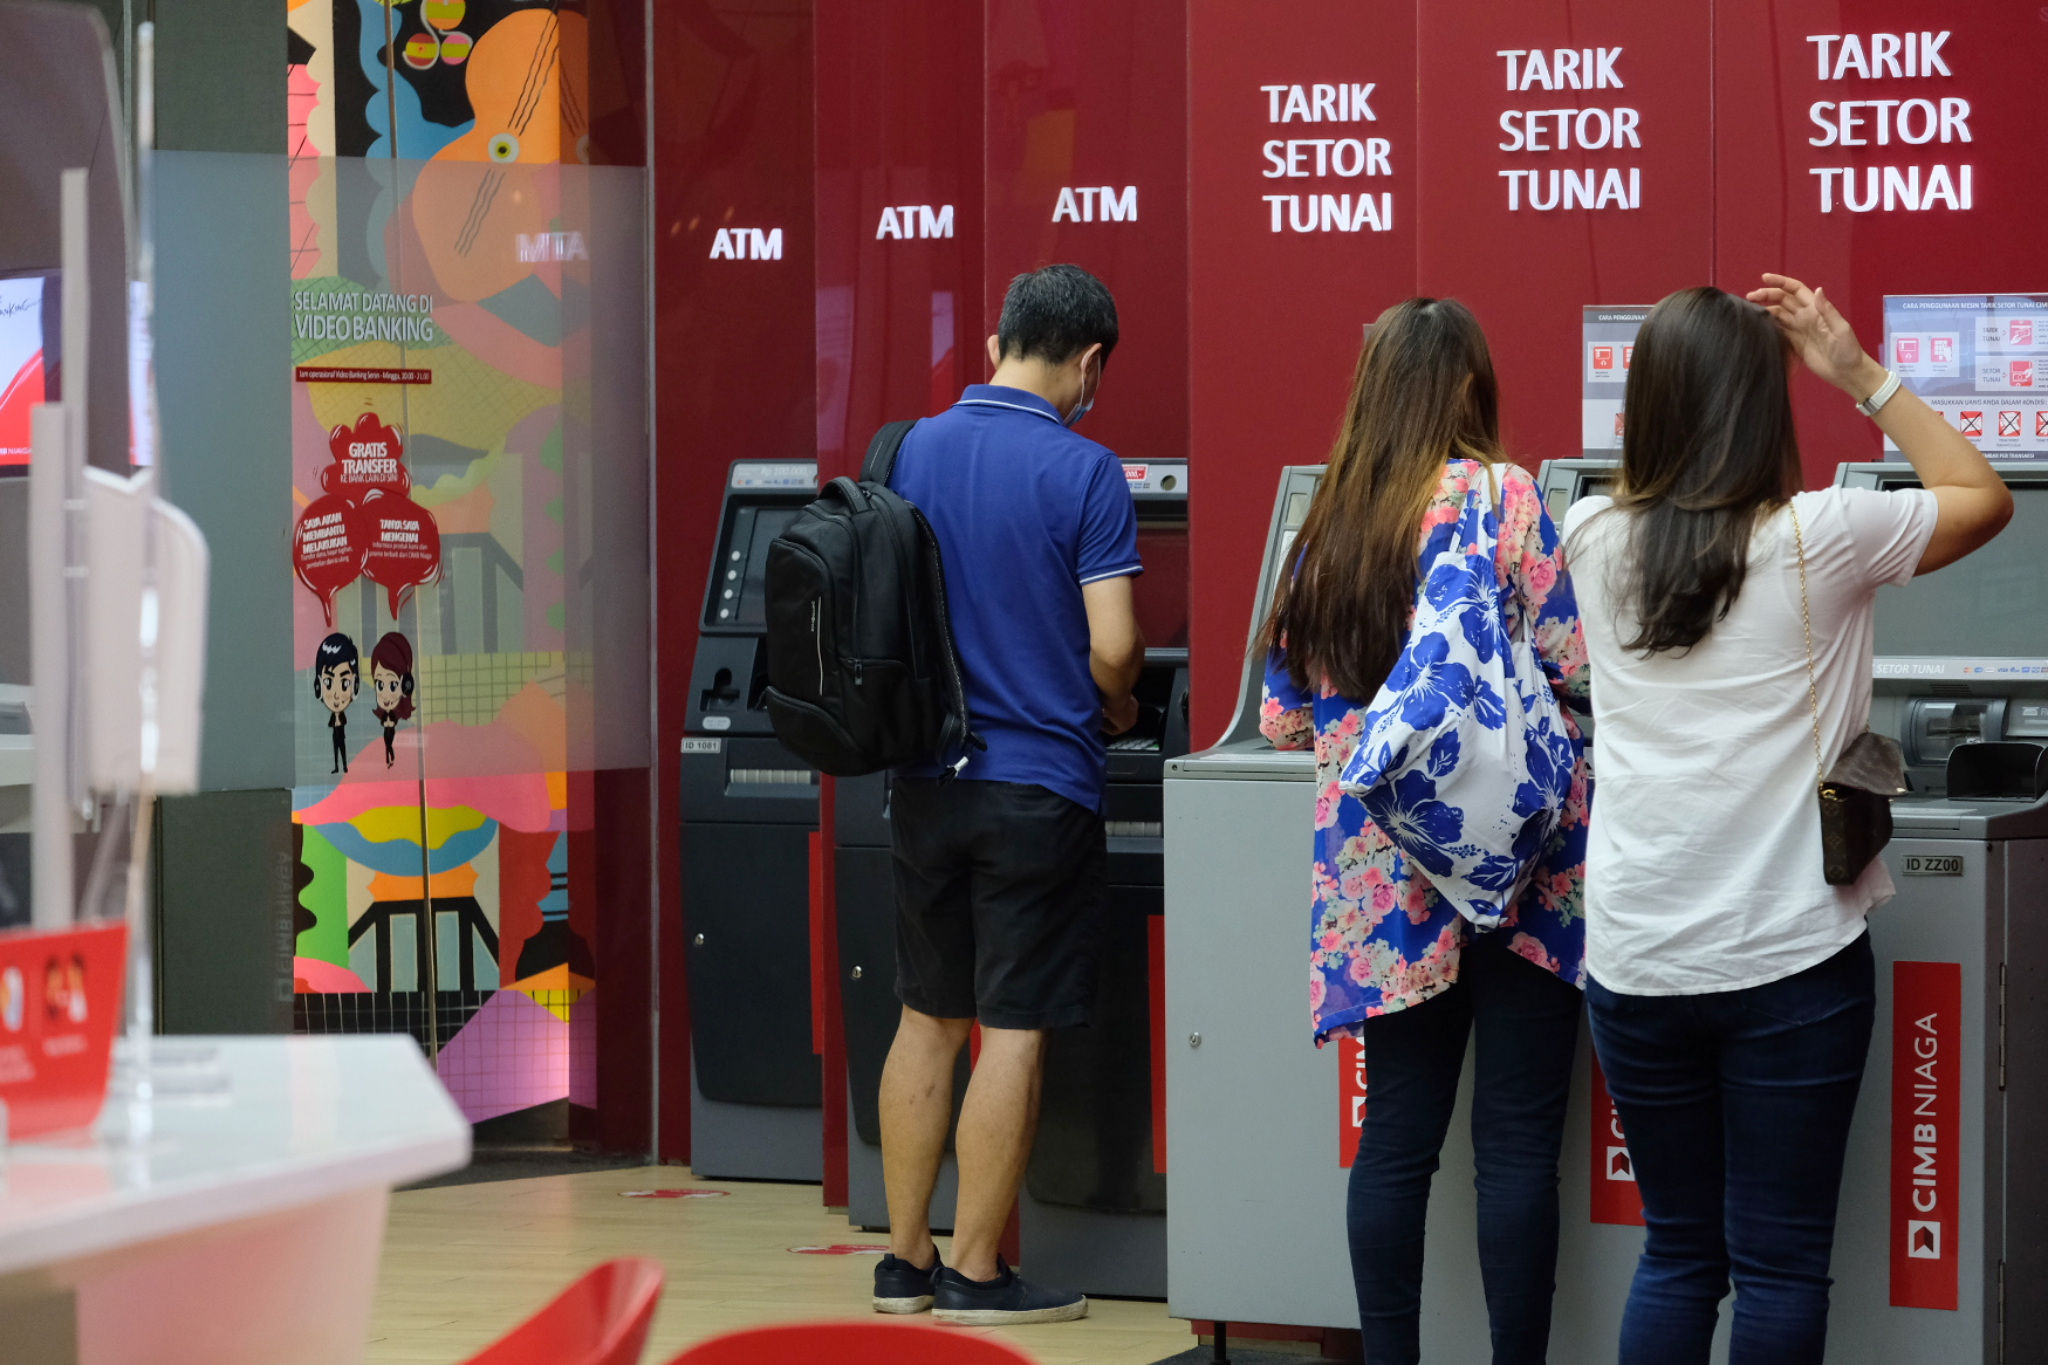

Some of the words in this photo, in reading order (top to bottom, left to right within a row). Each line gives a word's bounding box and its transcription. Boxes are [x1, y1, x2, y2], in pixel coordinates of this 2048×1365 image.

[1497, 47, 1624, 91] TARIK
[1806, 31, 1952, 80] TARIK
[1260, 83, 1377, 123] TARIK
[1808, 97, 1973, 147] SETOR
[1499, 107, 1641, 151] SETOR
[1262, 137, 1392, 178] SETOR
[1051, 185, 1138, 223] ATM
[1498, 167, 1641, 211] TUNAI
[1808, 164, 1972, 213] TUNAI
[875, 205, 954, 240] ATM
[1262, 192, 1392, 233] TUNAI
[709, 227, 783, 260] ATM
[294, 291, 359, 312] SELAMAT
[362, 293, 417, 313] DATANG
[419, 294, 433, 314] DI
[294, 313, 350, 341] VIDEO
[353, 315, 433, 342] BANKING
[341, 458, 398, 474] TRANSFER
[348, 442, 388, 458] GRATIS
[1875, 664, 1909, 674] SETOR
[1912, 664, 1945, 674] TUNAI
[685, 741, 694, 749] ID
[1906, 858, 1920, 871] ID
[1925, 858, 1959, 872] ZZ00
[1913, 1012, 1938, 1117] NIAGA
[1912, 1123, 1937, 1213] CIMB
